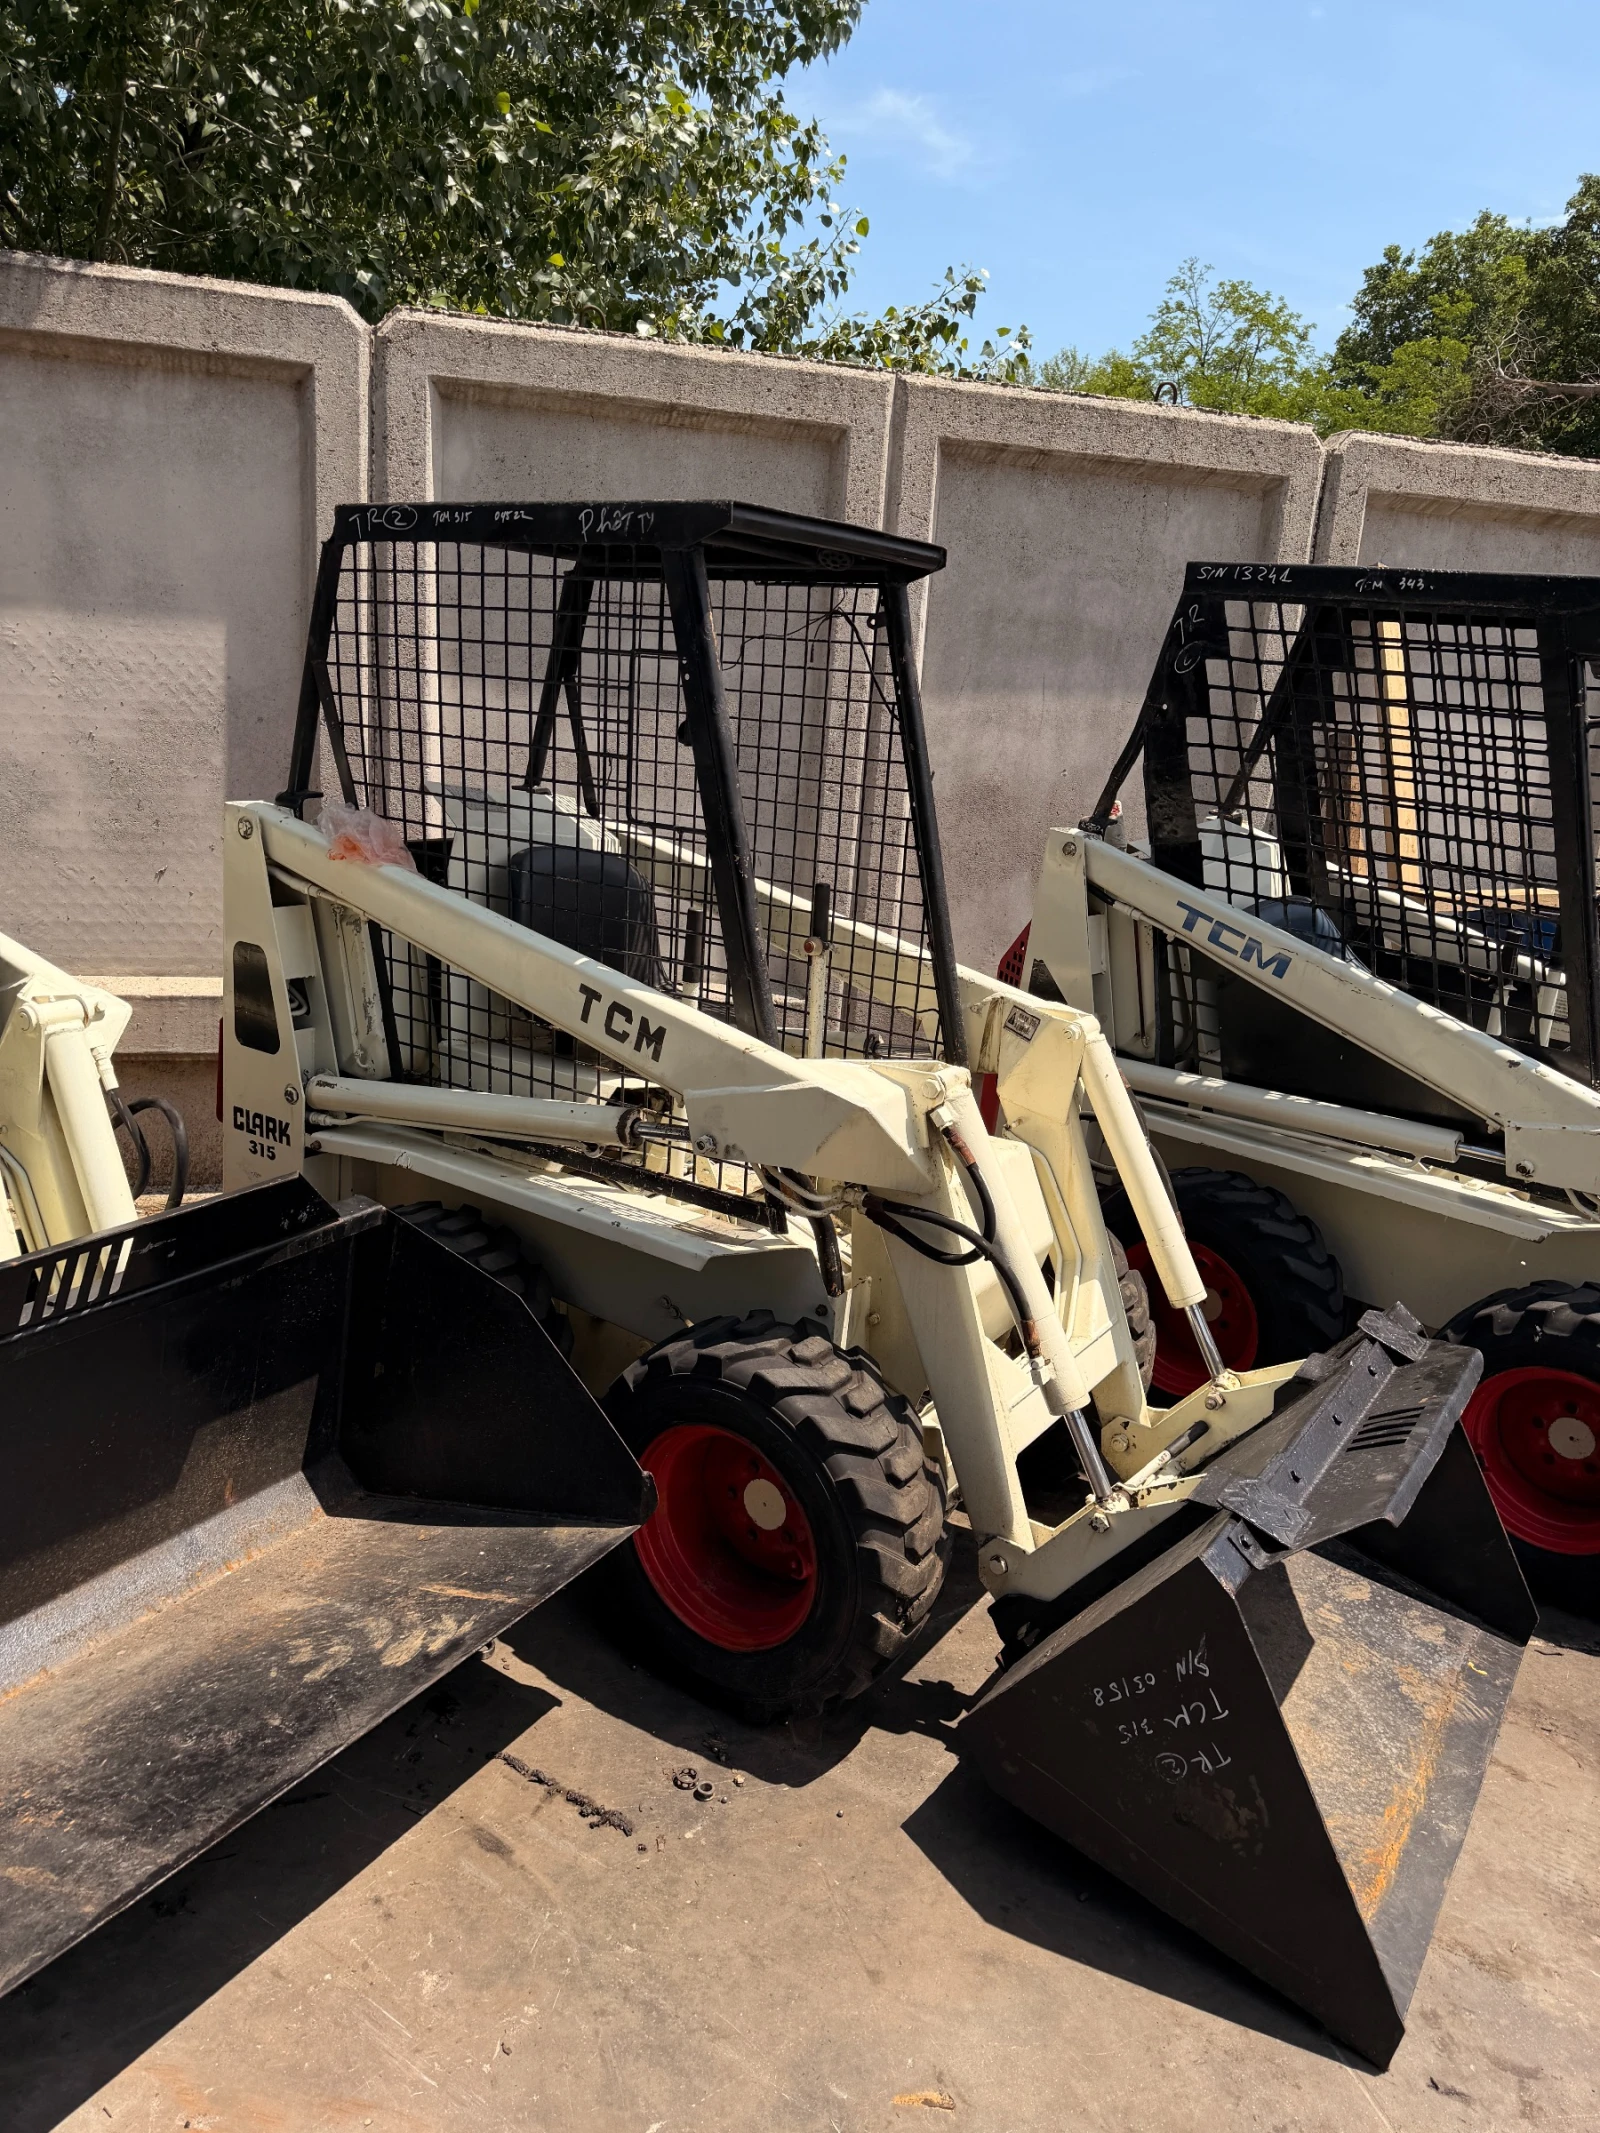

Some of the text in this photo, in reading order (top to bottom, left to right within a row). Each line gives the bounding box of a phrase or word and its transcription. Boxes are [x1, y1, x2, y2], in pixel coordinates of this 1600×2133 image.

[454, 510, 473, 523] 315
[1233, 565, 1293, 585] 13241
[1176, 899, 1293, 980] TCM
[578, 982, 668, 1063] TCM
[232, 1104, 292, 1148] CLARK
[248, 1139, 277, 1161] 315
[1118, 1717, 1154, 1745] 315
